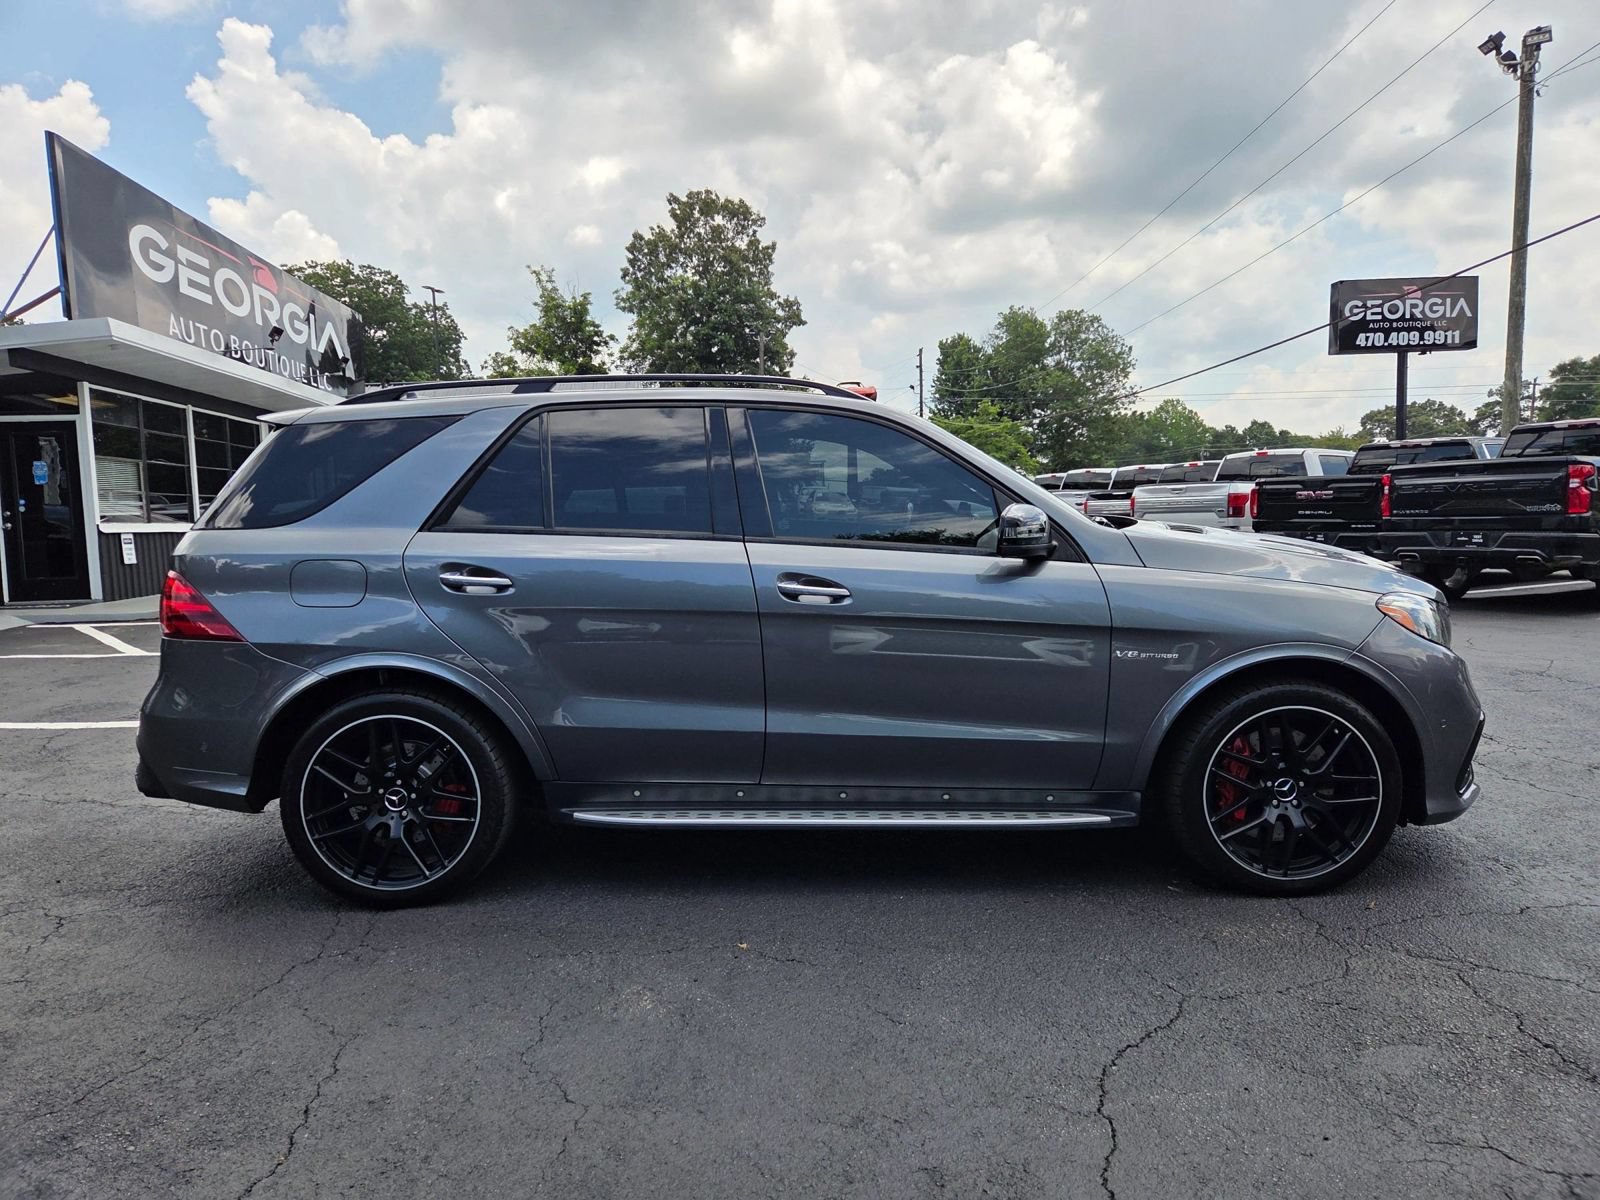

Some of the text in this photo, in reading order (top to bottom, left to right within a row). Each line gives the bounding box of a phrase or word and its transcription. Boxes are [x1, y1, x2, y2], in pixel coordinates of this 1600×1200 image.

[129, 224, 346, 359] GEORGIA
[1344, 298, 1473, 320] GEORGIA
[1355, 330, 1460, 346] 470.409.9911
[168, 312, 333, 391] AUTO BOUTIQUE LLC
[1295, 490, 1334, 499] GMC
